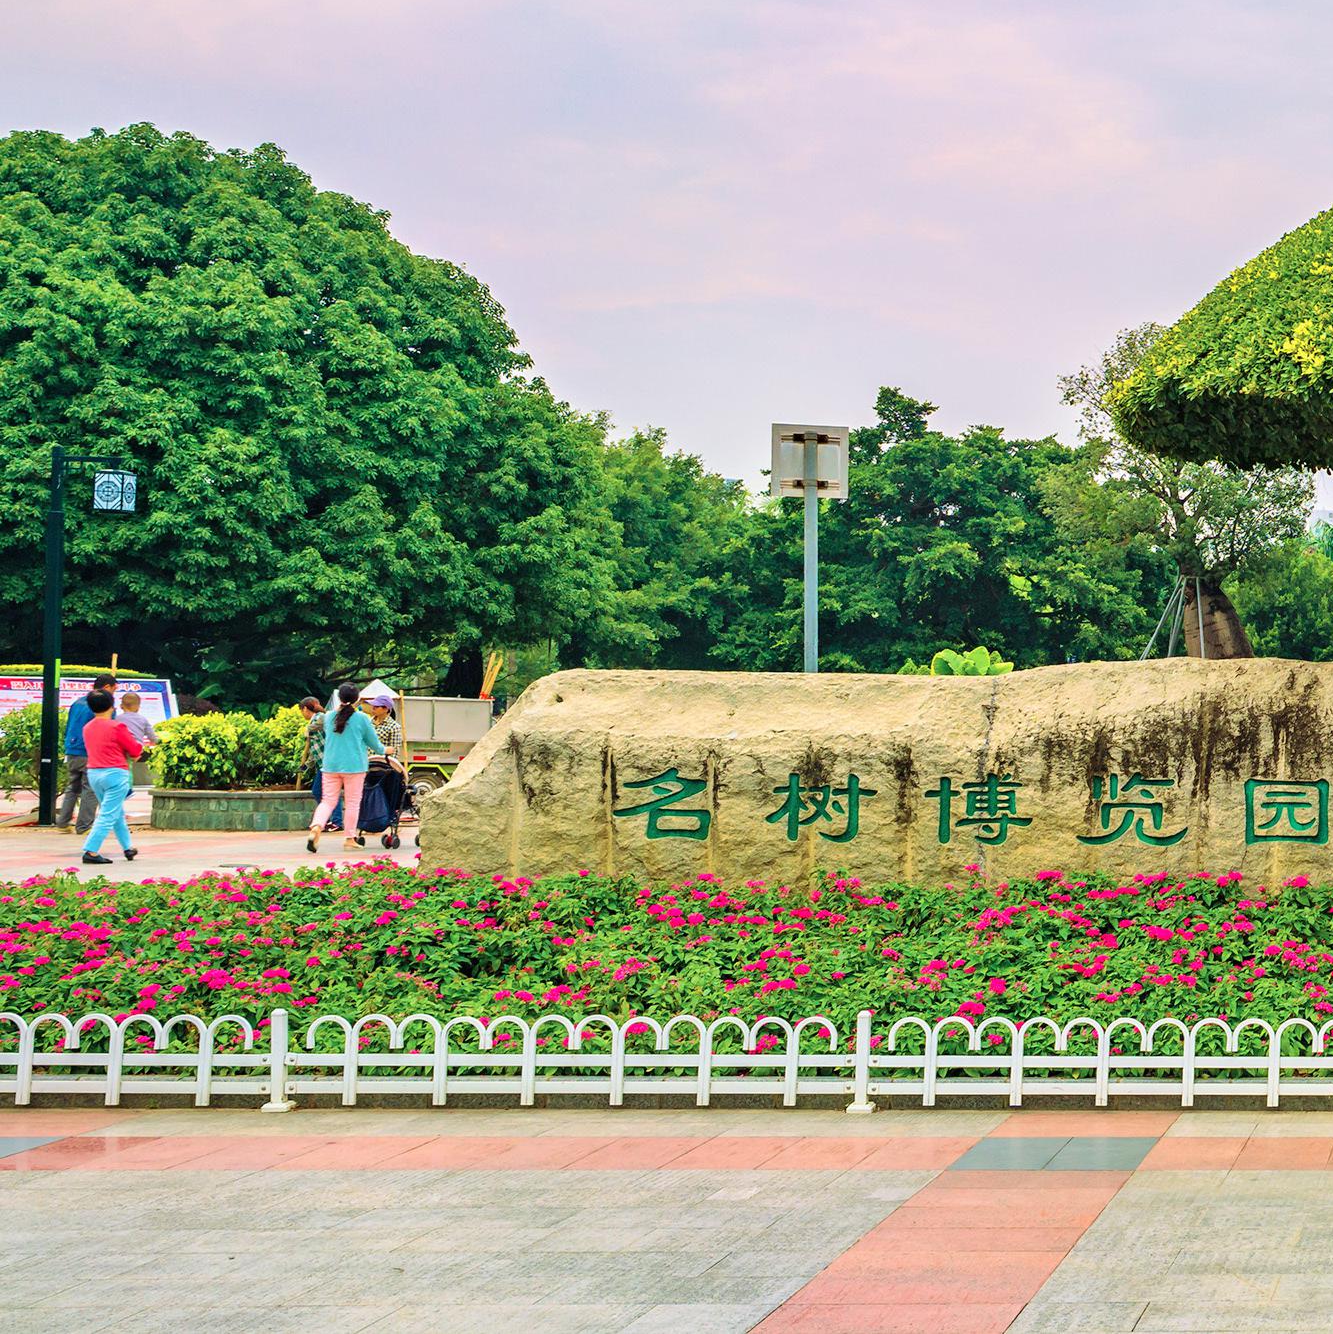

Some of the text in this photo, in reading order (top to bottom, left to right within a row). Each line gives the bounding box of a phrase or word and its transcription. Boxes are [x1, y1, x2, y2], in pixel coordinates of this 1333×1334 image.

[612, 767, 1330, 846] 名树博览园
